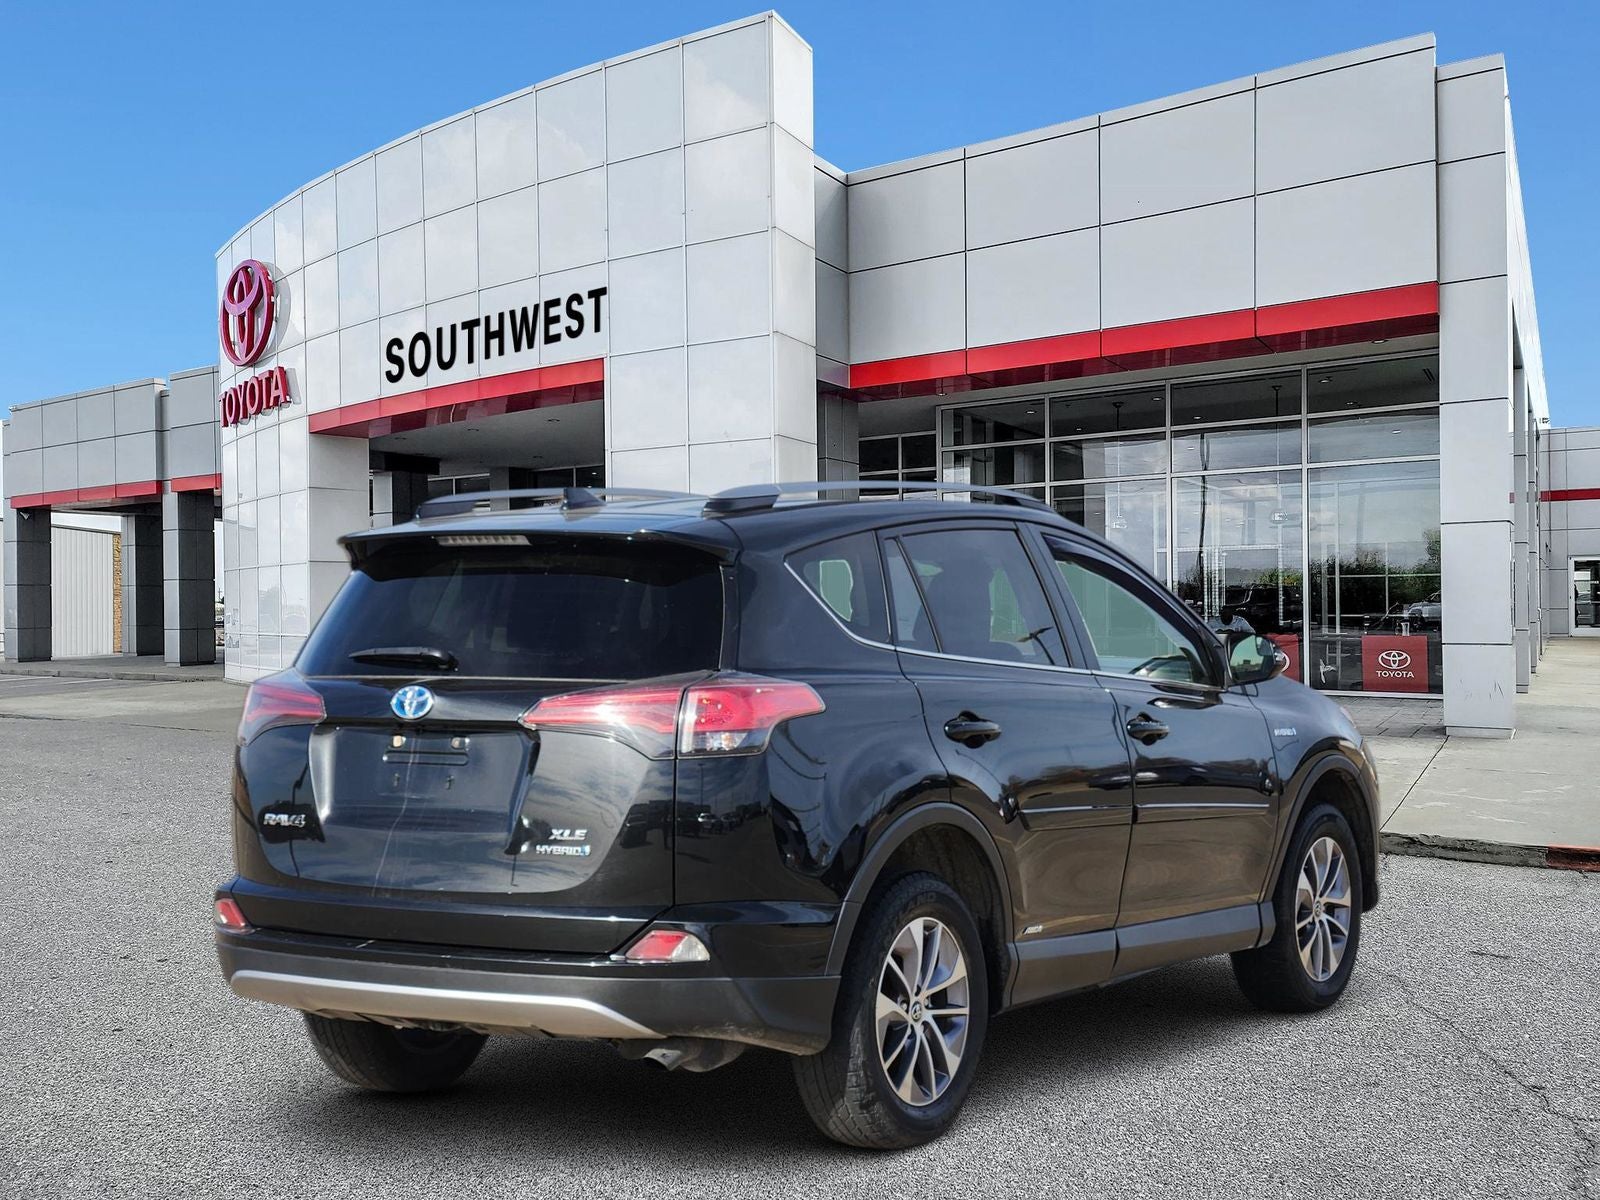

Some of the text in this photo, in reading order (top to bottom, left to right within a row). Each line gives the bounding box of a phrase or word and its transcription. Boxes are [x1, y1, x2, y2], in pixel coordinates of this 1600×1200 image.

[385, 286, 607, 383] SOUTHWEST
[219, 366, 290, 428] TOYOTA
[1376, 670, 1414, 678] TOYOTA
[263, 813, 306, 828] RAV4
[548, 828, 588, 840] XLE
[535, 844, 581, 856] HYBRID
